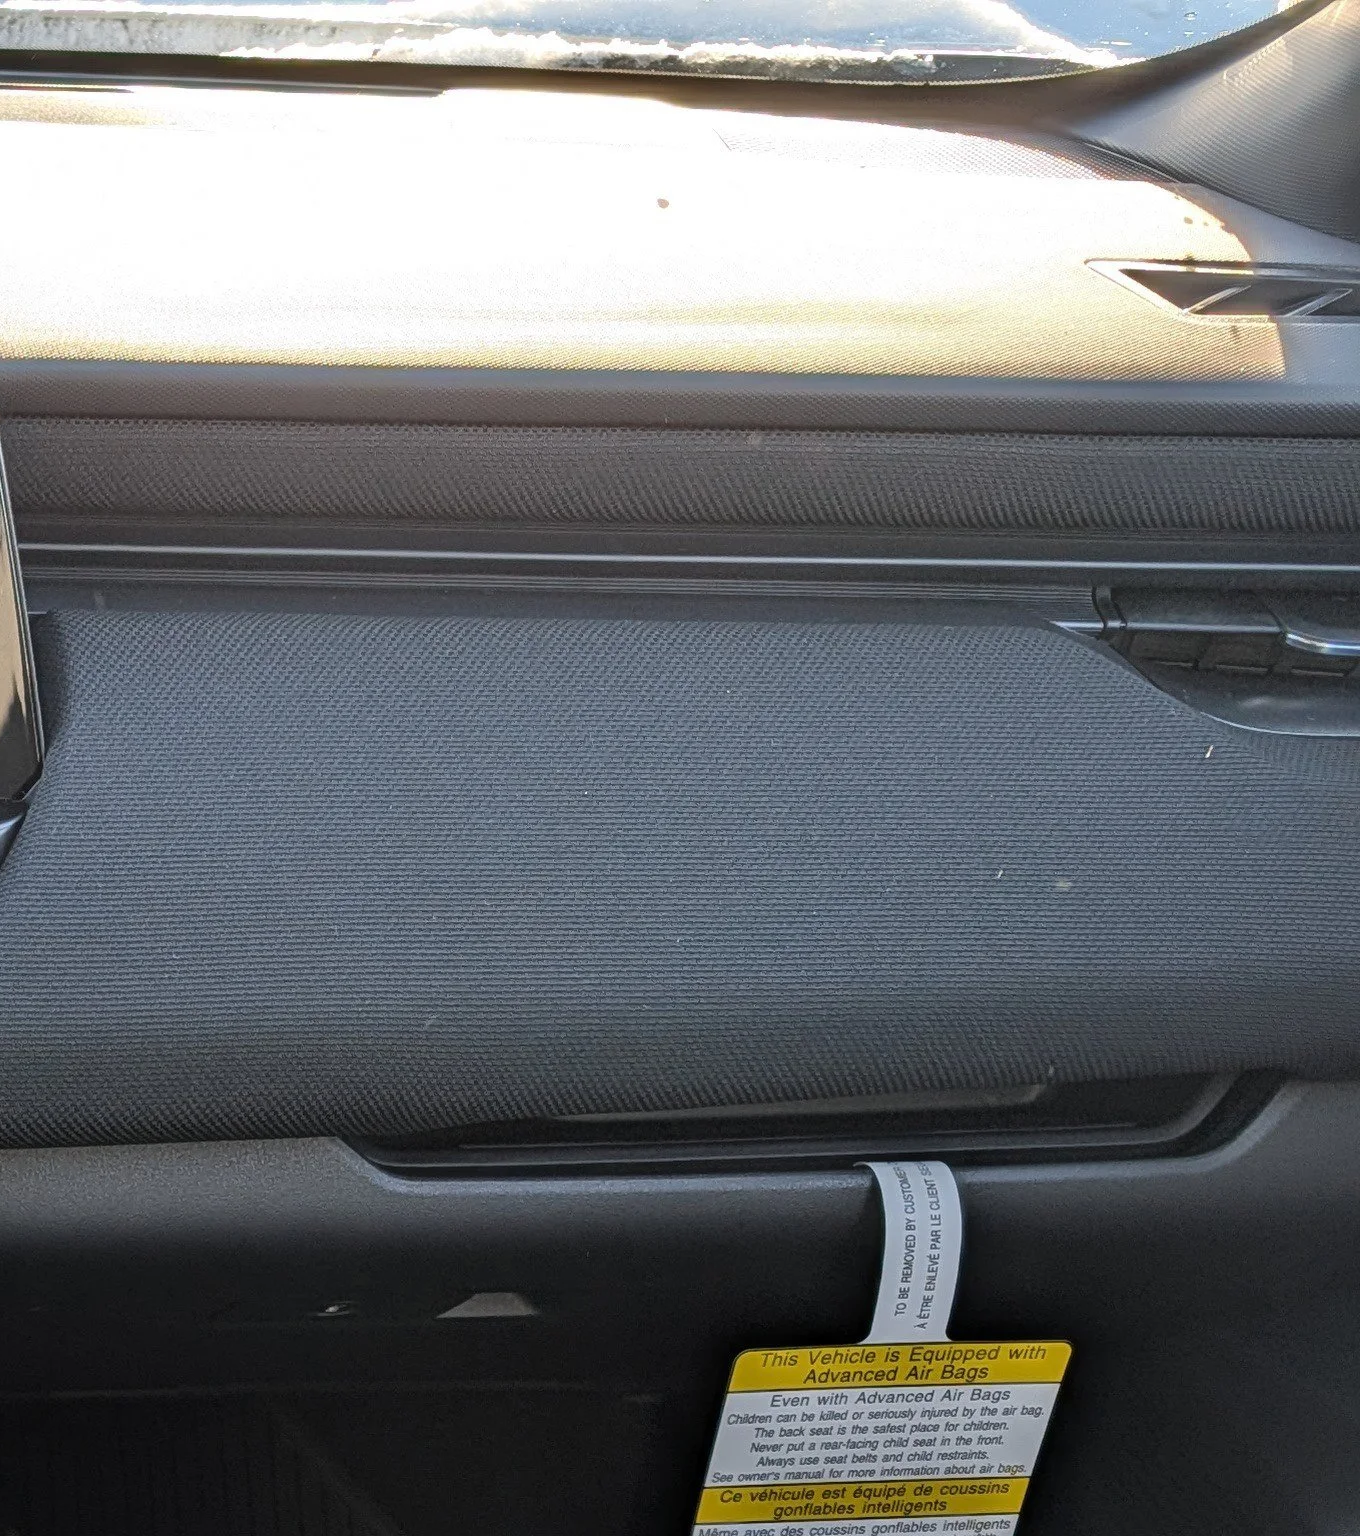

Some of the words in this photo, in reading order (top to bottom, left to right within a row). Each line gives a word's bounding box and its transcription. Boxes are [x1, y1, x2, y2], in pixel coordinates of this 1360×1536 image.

[925, 1179, 940, 1211] CLIENT
[906, 1218, 916, 1235] BY
[932, 1214, 941, 1226] LE
[930, 1229, 941, 1250] PAR
[902, 1234, 916, 1283] REMOVED
[898, 1286, 910, 1301] BE
[895, 1302, 907, 1316] TO
[760, 1352, 798, 1368] This
[808, 1348, 876, 1365] Vehicle
[884, 1348, 900, 1363] is
[909, 1346, 1001, 1364] Equipped
[1009, 1346, 1046, 1360] with
[803, 1367, 898, 1384] Advanced
[905, 1365, 932, 1381] Air
[940, 1364, 989, 1382] Bags
[770, 1394, 810, 1408] Even
[817, 1392, 848, 1406] with
[855, 1390, 935, 1404] Advanced
[940, 1389, 964, 1402] Air
[970, 1388, 1011, 1403] Bags
[727, 1413, 771, 1425] Children
[776, 1414, 796, 1423] can
[801, 1411, 815, 1422] be
[852, 1412, 863, 1420] or
[868, 1408, 916, 1421] seriously
[920, 1407, 958, 1420] injured
[962, 1406, 977, 1418] by
[980, 1406, 999, 1416] the
[1002, 1407, 1018, 1416] air
[1021, 1405, 1044, 1417] bag.
[755, 1427, 774, 1438] The
[779, 1425, 805, 1437] back
[810, 1425, 834, 1436] seat
[837, 1425, 846, 1435] is
[851, 1424, 869, 1434] the
[872, 1423, 906, 1434] safest
[910, 1422, 940, 1435] place
[944, 1421, 960, 1432] for
[963, 1421, 1009, 1431] children.
[750, 1442, 783, 1453] Never
[786, 1441, 805, 1453] put
[808, 1443, 816, 1451] a
[820, 1438, 879, 1451] rear-facing
[883, 1436, 909, 1448] child
[913, 1436, 936, 1448] seat
[940, 1436, 951, 1446] in
[956, 1436, 972, 1446] the
[977, 1434, 1004, 1445] front.
[756, 1456, 795, 1468] Always
[799, 1457, 819, 1466] use
[823, 1454, 848, 1465] seat
[851, 1453, 877, 1464] belts
[882, 1452, 903, 1462] and
[907, 1451, 933, 1461] child
[937, 1450, 989, 1460] restraints.
[720, 1490, 743, 1503] Ce
[750, 1487, 815, 1502] véhicule
[821, 1486, 847, 1499] est
[853, 1482, 906, 1498] équipé
[913, 1483, 933, 1497] de
[940, 1482, 1010, 1495] coussins
[773, 1502, 855, 1520] gonflables
[862, 1500, 947, 1515] intelligents
